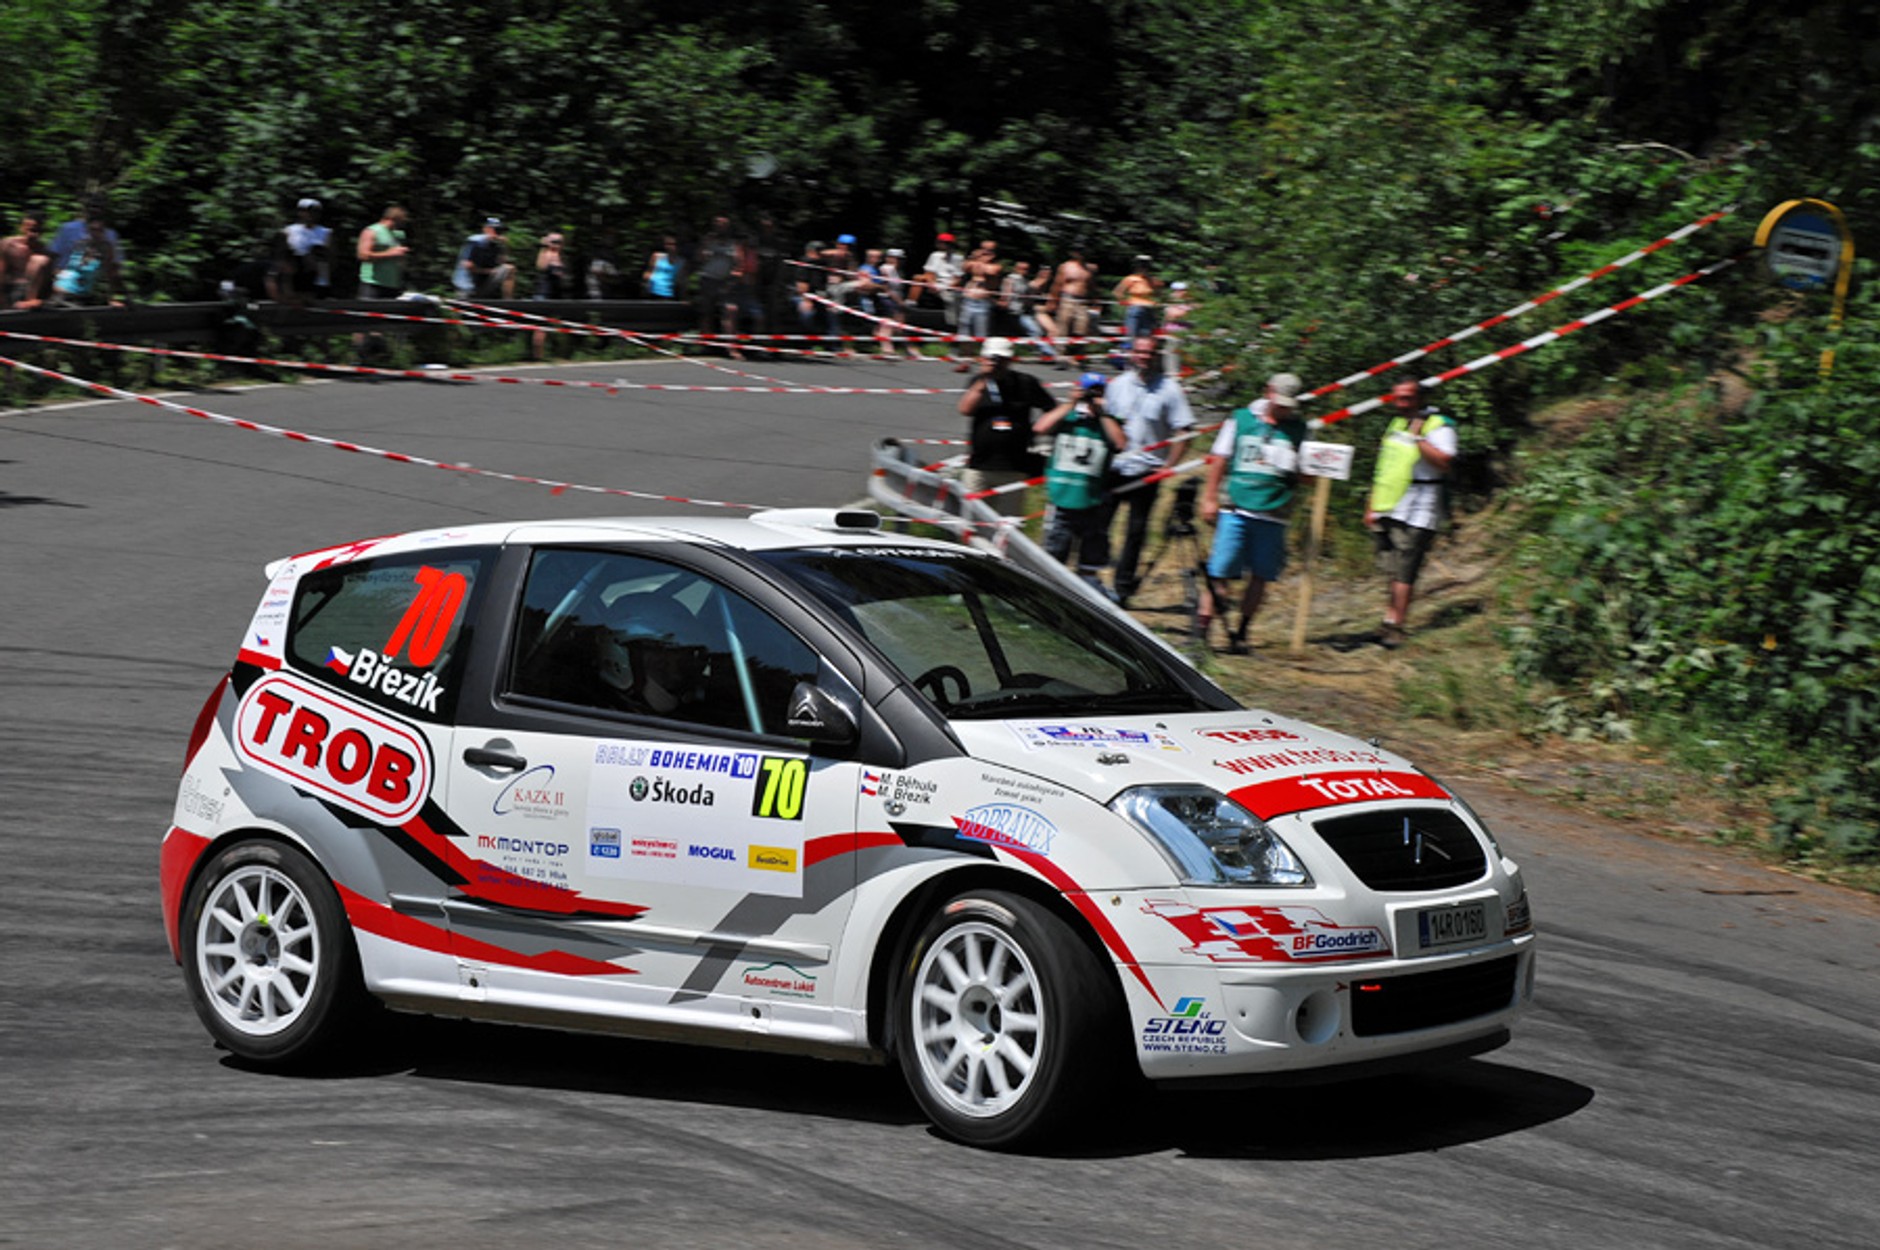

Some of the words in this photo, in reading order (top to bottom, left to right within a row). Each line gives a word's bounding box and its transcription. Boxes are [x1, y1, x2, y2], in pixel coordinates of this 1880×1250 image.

[383, 565, 467, 668] 70
[349, 648, 445, 713] Březík
[252, 690, 416, 804] TROB
[1205, 729, 1301, 744] TROB
[595, 744, 650, 766] RALLY
[650, 750, 732, 773] BOHEMIA
[758, 758, 806, 819] 70
[877, 785, 891, 796] M.
[879, 773, 893, 785] M.
[1298, 777, 1415, 801] TOTAL
[514, 788, 551, 805] KAZK
[651, 776, 715, 807] Škoda
[959, 808, 1057, 852] DOPRAVEX
[687, 845, 737, 861] MOGUL
[1292, 928, 1378, 951] BFGoodrich
[1143, 1018, 1227, 1035] STENO
[1143, 1043, 1227, 1054] WWW.STENO.CZ
[1178, 1036, 1226, 1044] REPUBLIC
